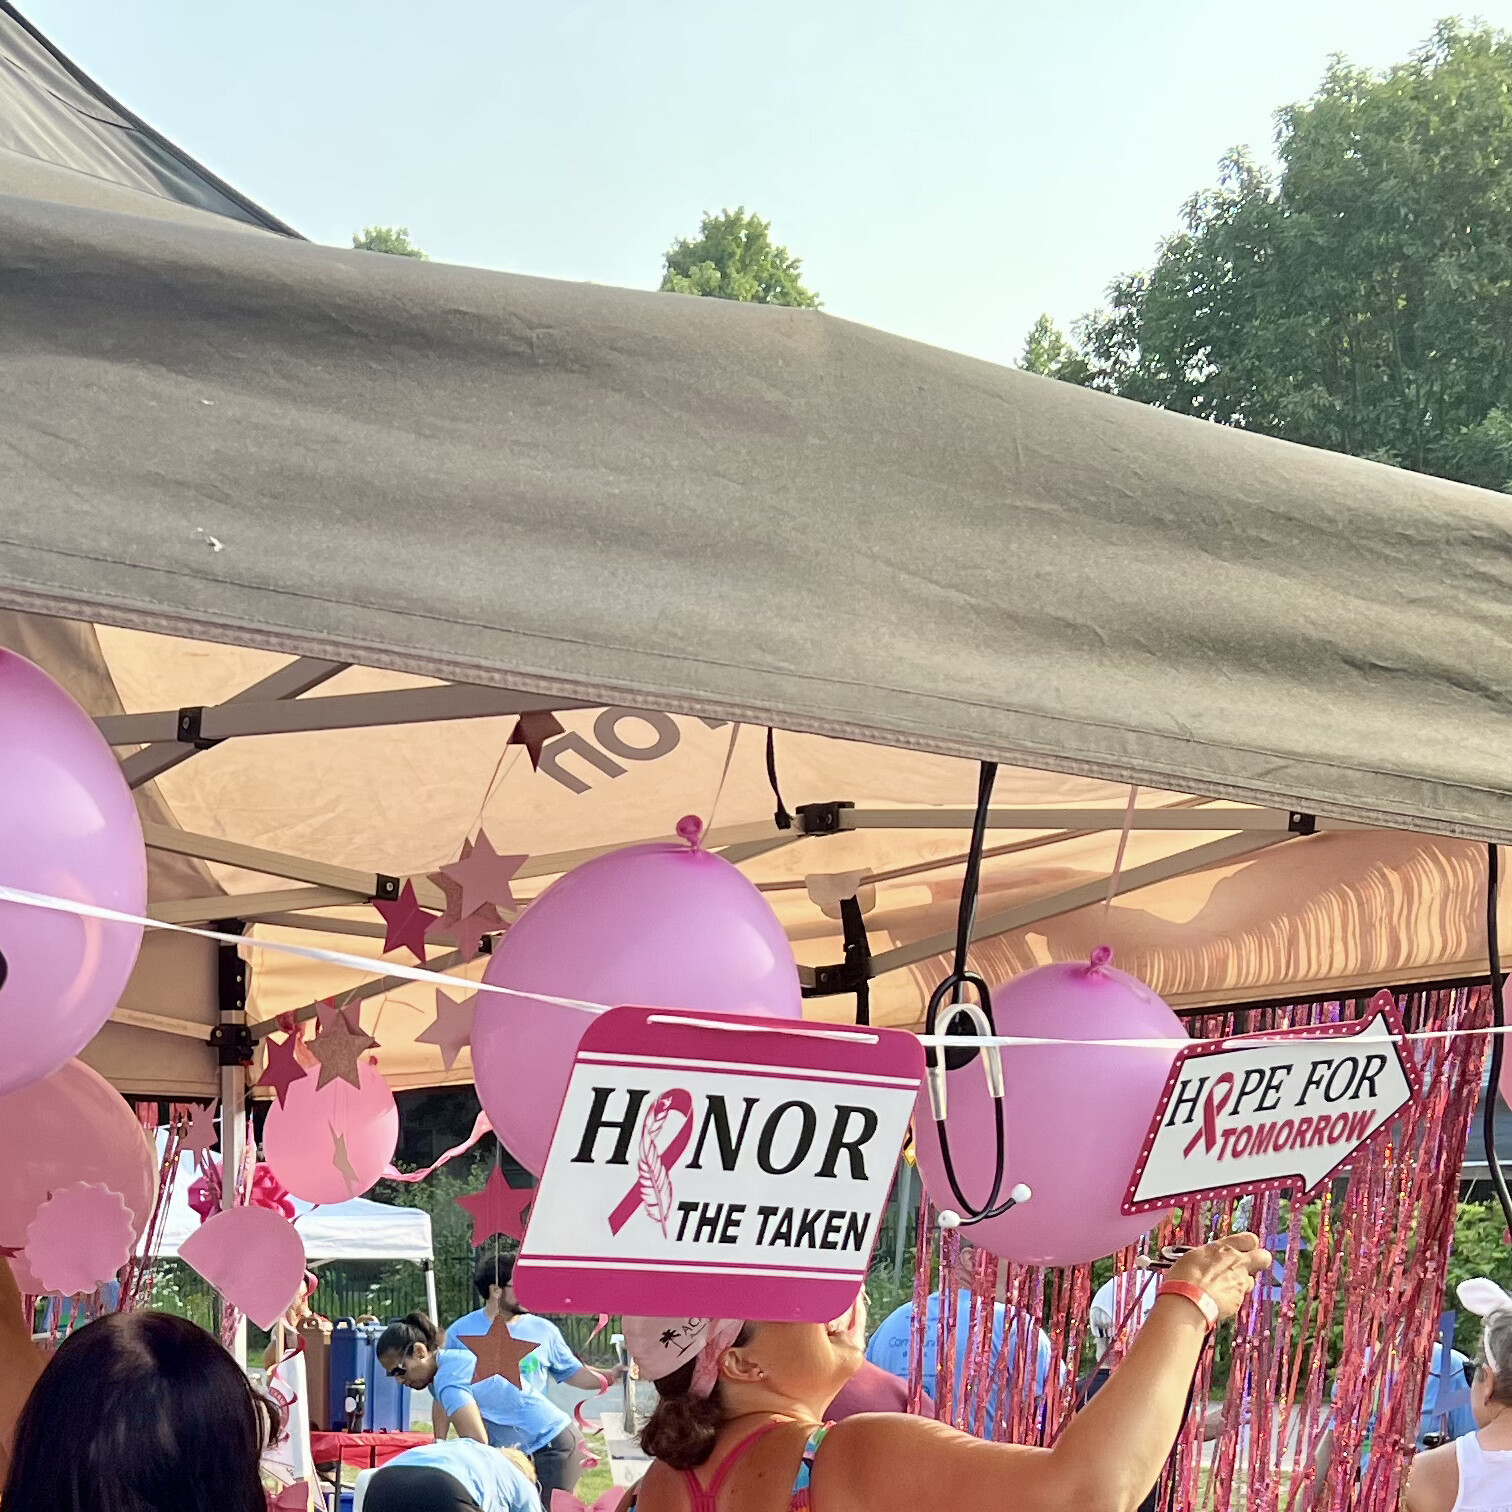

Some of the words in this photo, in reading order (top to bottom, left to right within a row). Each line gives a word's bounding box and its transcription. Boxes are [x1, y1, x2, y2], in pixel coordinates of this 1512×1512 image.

[1294, 1053, 1388, 1107] FOR
[1216, 1108, 1377, 1162] TOMORROW
[675, 1200, 747, 1245] THE
[755, 1204, 871, 1252] TAKEN
